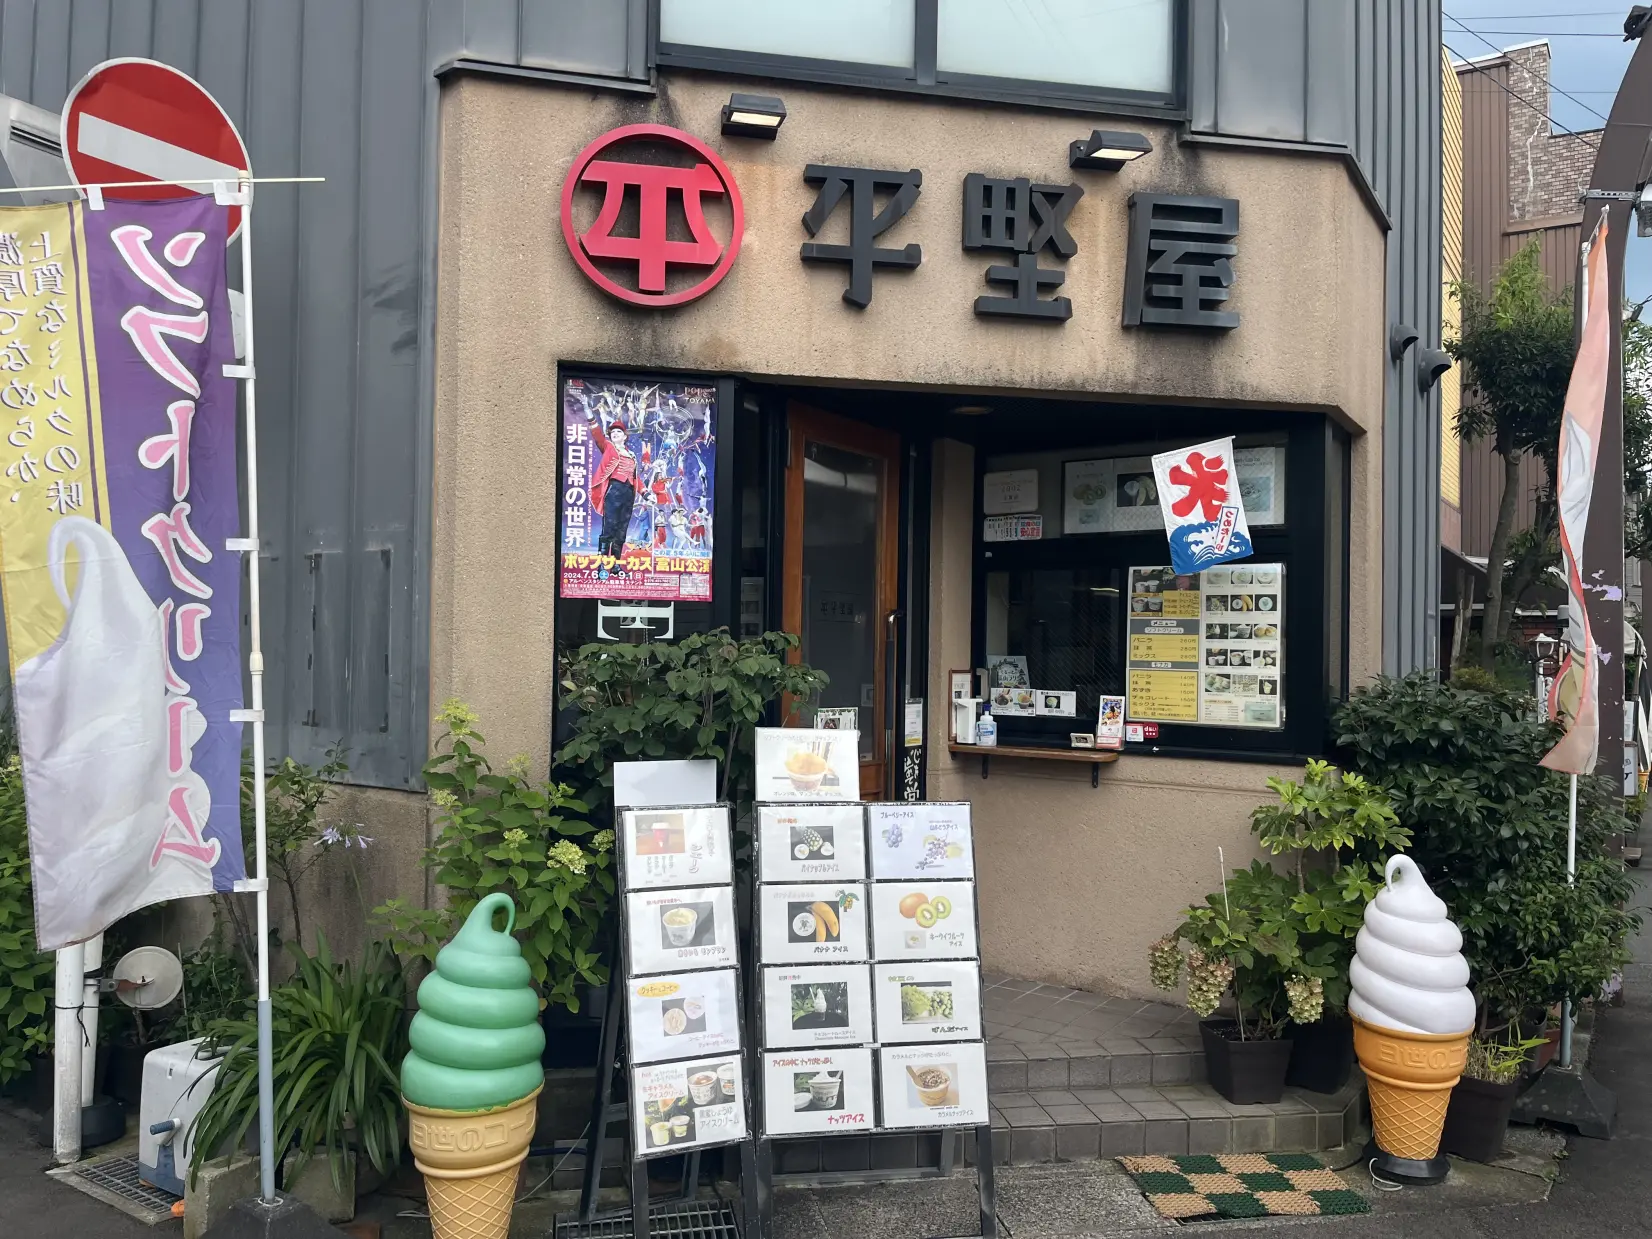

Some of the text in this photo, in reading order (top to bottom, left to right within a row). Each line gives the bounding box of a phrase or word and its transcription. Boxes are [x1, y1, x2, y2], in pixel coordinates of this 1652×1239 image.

[564, 423, 588, 548] 非日常の世界
[1168, 451, 1230, 522] 氷
[564, 553, 652, 571] ポップサーカス
[1379, 1040, 1468, 1069] 日世のコ
[827, 1113, 866, 1125] ナッツアイス
